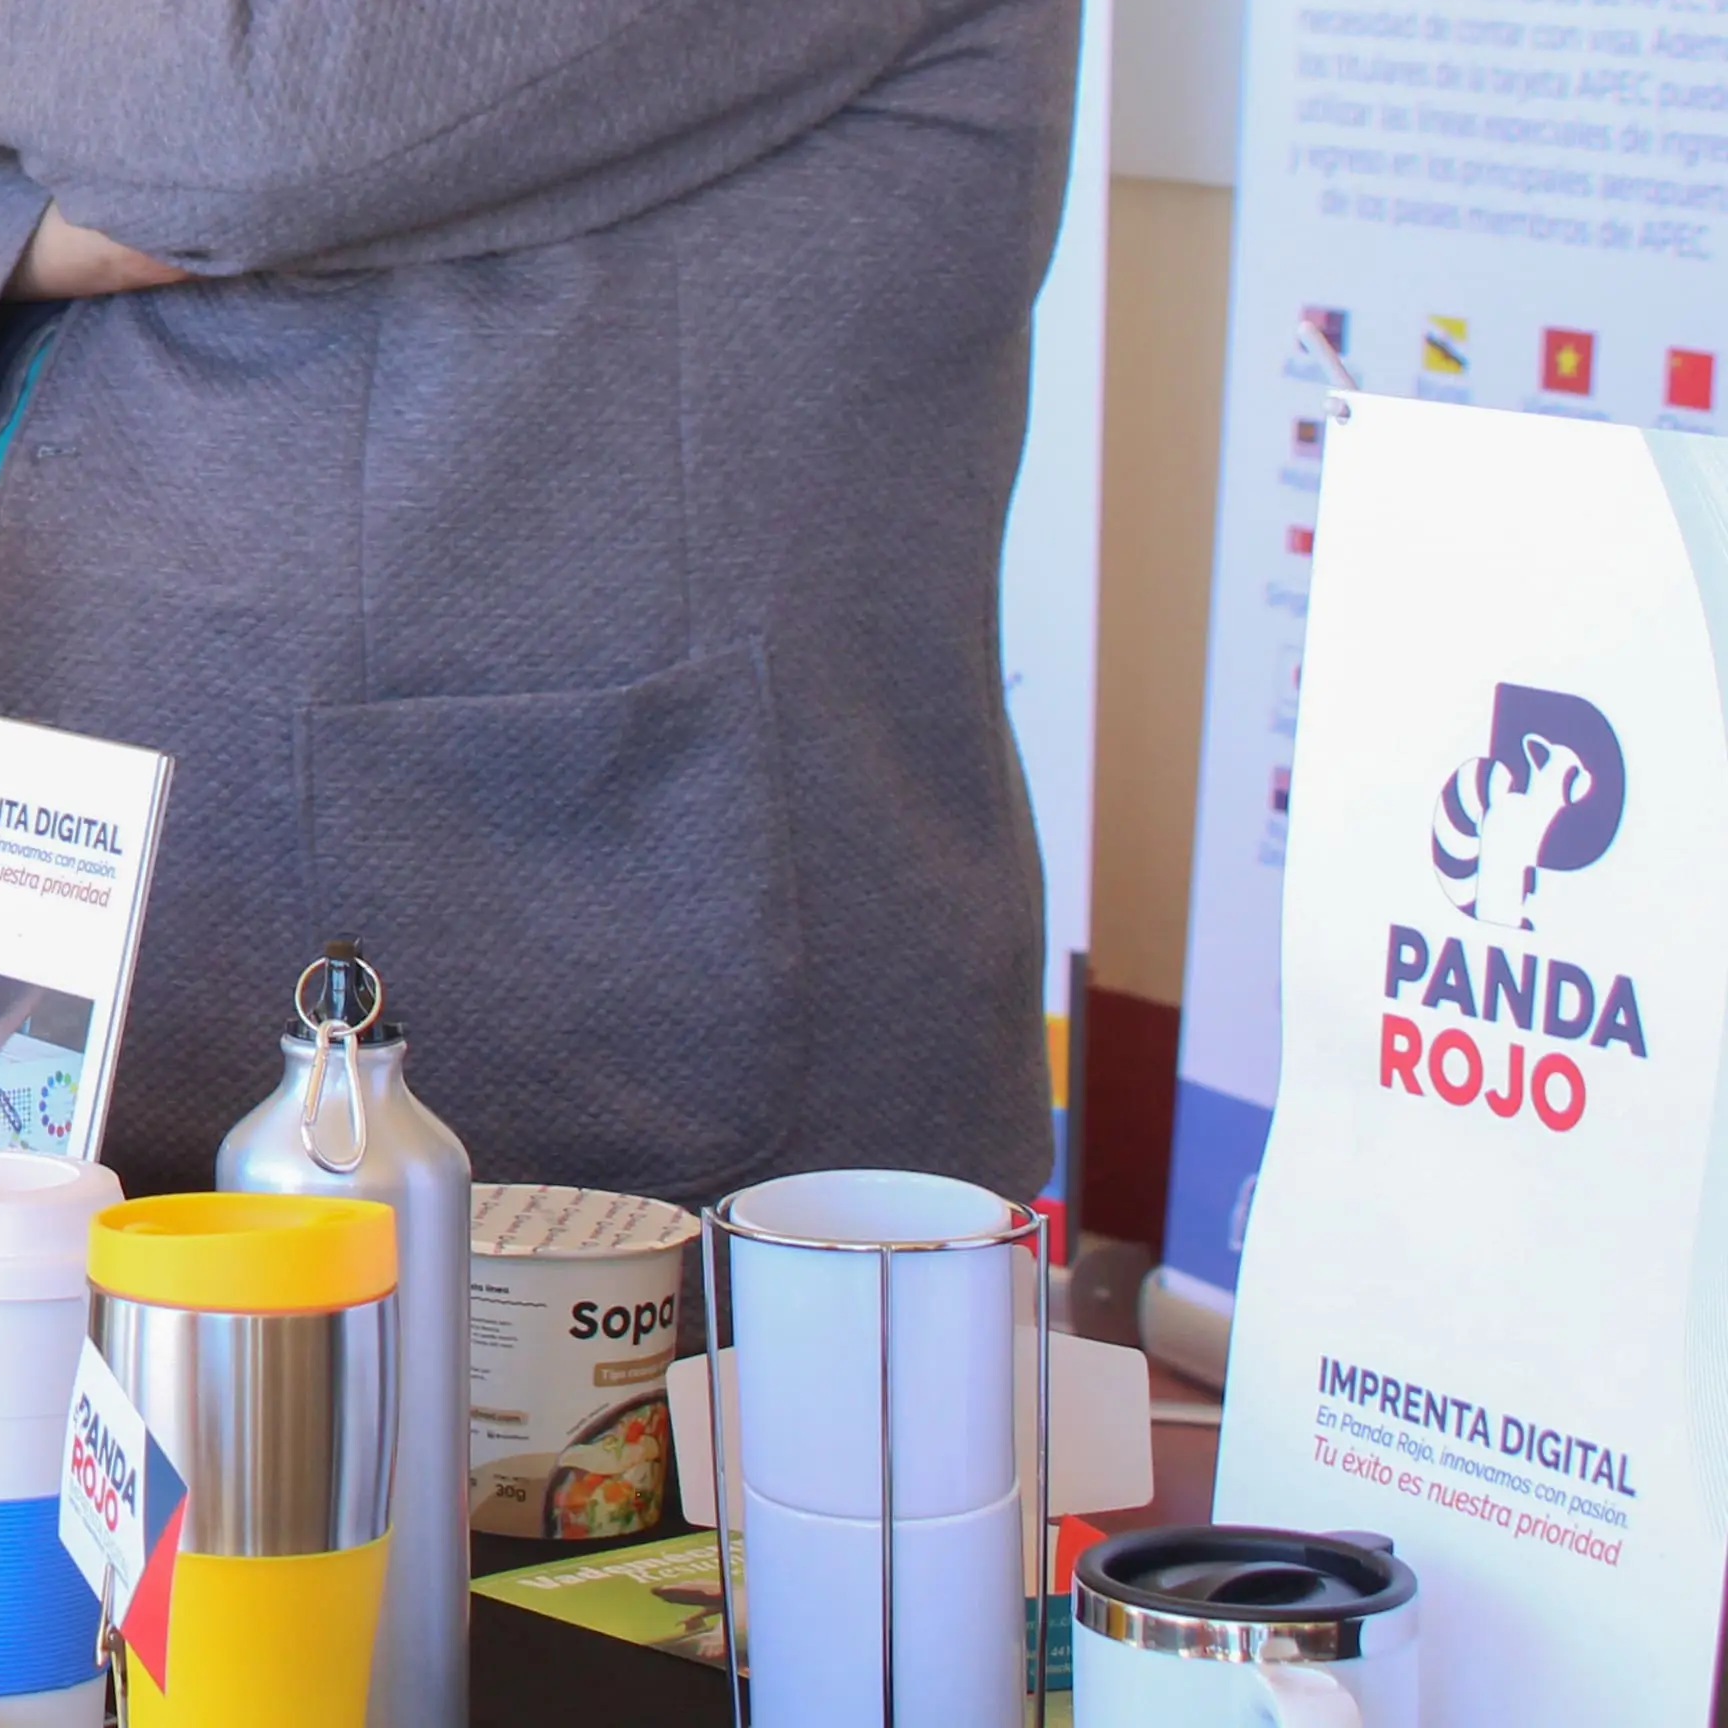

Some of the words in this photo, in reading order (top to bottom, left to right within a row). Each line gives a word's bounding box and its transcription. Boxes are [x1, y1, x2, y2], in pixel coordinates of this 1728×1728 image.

[35, 805, 124, 856] DIGITAL
[40, 869, 110, 908] prioridad
[1383, 922, 1649, 1060] PANDA
[1379, 1013, 1587, 1132] ROJO
[569, 1289, 676, 1346] Sopa
[74, 1392, 136, 1518] PANDA
[1315, 1404, 1338, 1429] En
[1341, 1413, 1393, 1450] Panda
[1440, 1447, 1531, 1495] innovamos
[1535, 1480, 1567, 1508] con
[1317, 1354, 1491, 1448] IMPRENTA
[1498, 1413, 1638, 1499] DIGITAL
[71, 1433, 118, 1532] ROJO
[1314, 1434, 1337, 1467] Tu
[1341, 1447, 1393, 1486] éxito
[1397, 1471, 1422, 1497] es
[1427, 1480, 1512, 1528] nuestra
[1514, 1509, 1623, 1568] prioridad
